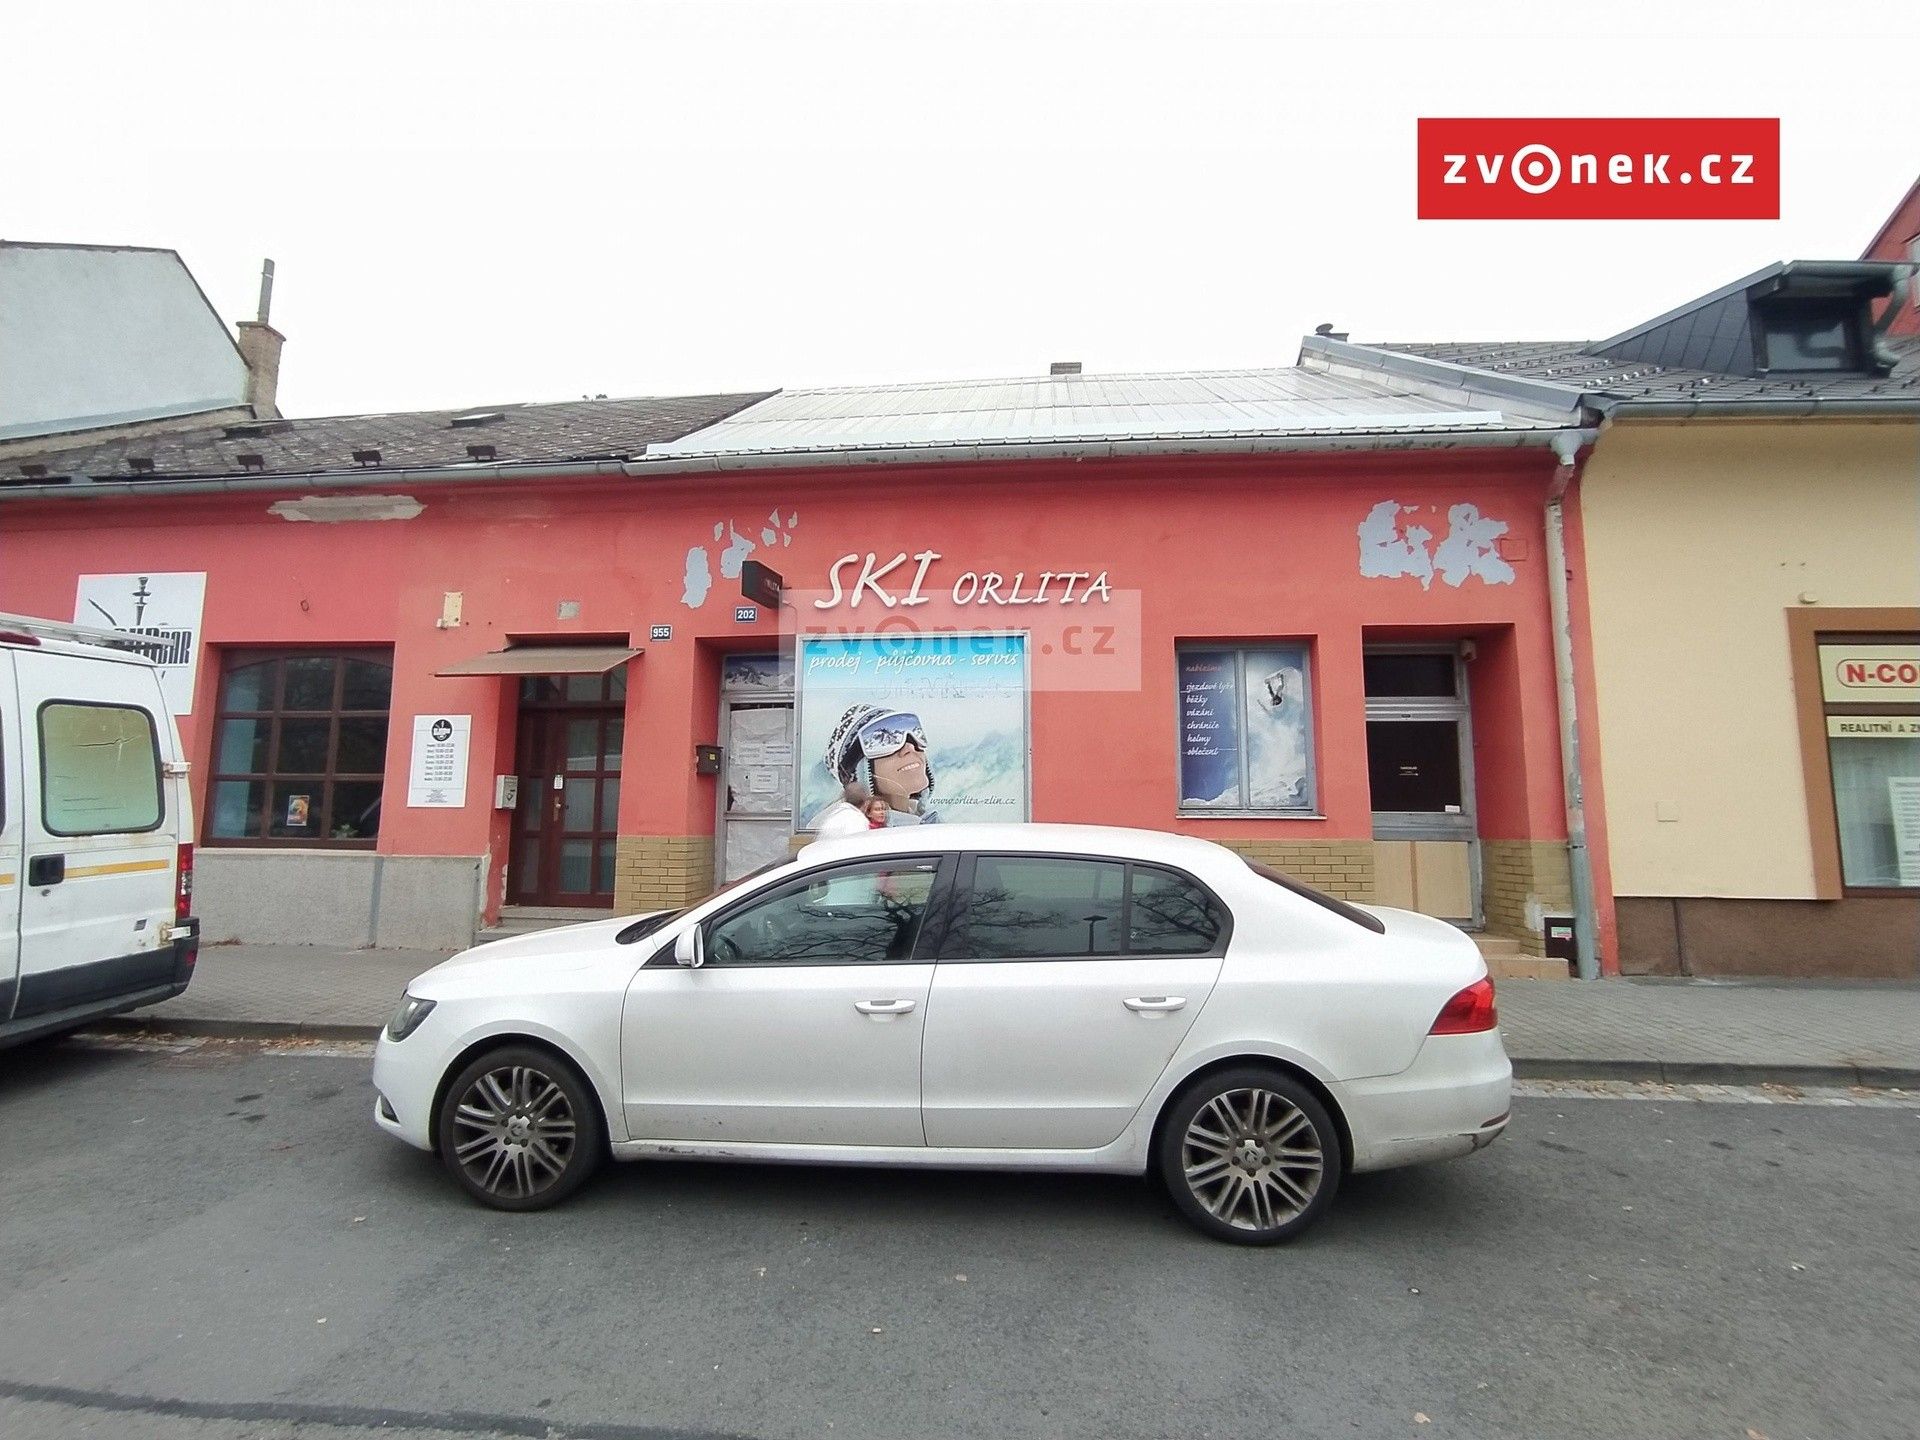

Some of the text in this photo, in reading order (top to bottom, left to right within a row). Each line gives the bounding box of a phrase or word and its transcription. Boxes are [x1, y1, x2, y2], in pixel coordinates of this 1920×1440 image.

[814, 549, 1113, 609] SKI ORLITA
[737, 610, 755, 620] 202
[652, 627, 670, 639] 955
[808, 650, 862, 675] prodej
[874, 649, 956, 675] půjčovna
[971, 650, 1019, 667] servis
[1846, 664, 1920, 684] N-CO
[1840, 721, 1893, 733] REALITNÍ
[1897, 723, 1906, 733] A
[1187, 734, 1212, 746] helmy
[929, 795, 1017, 806] www.orlita-zlin.cz
